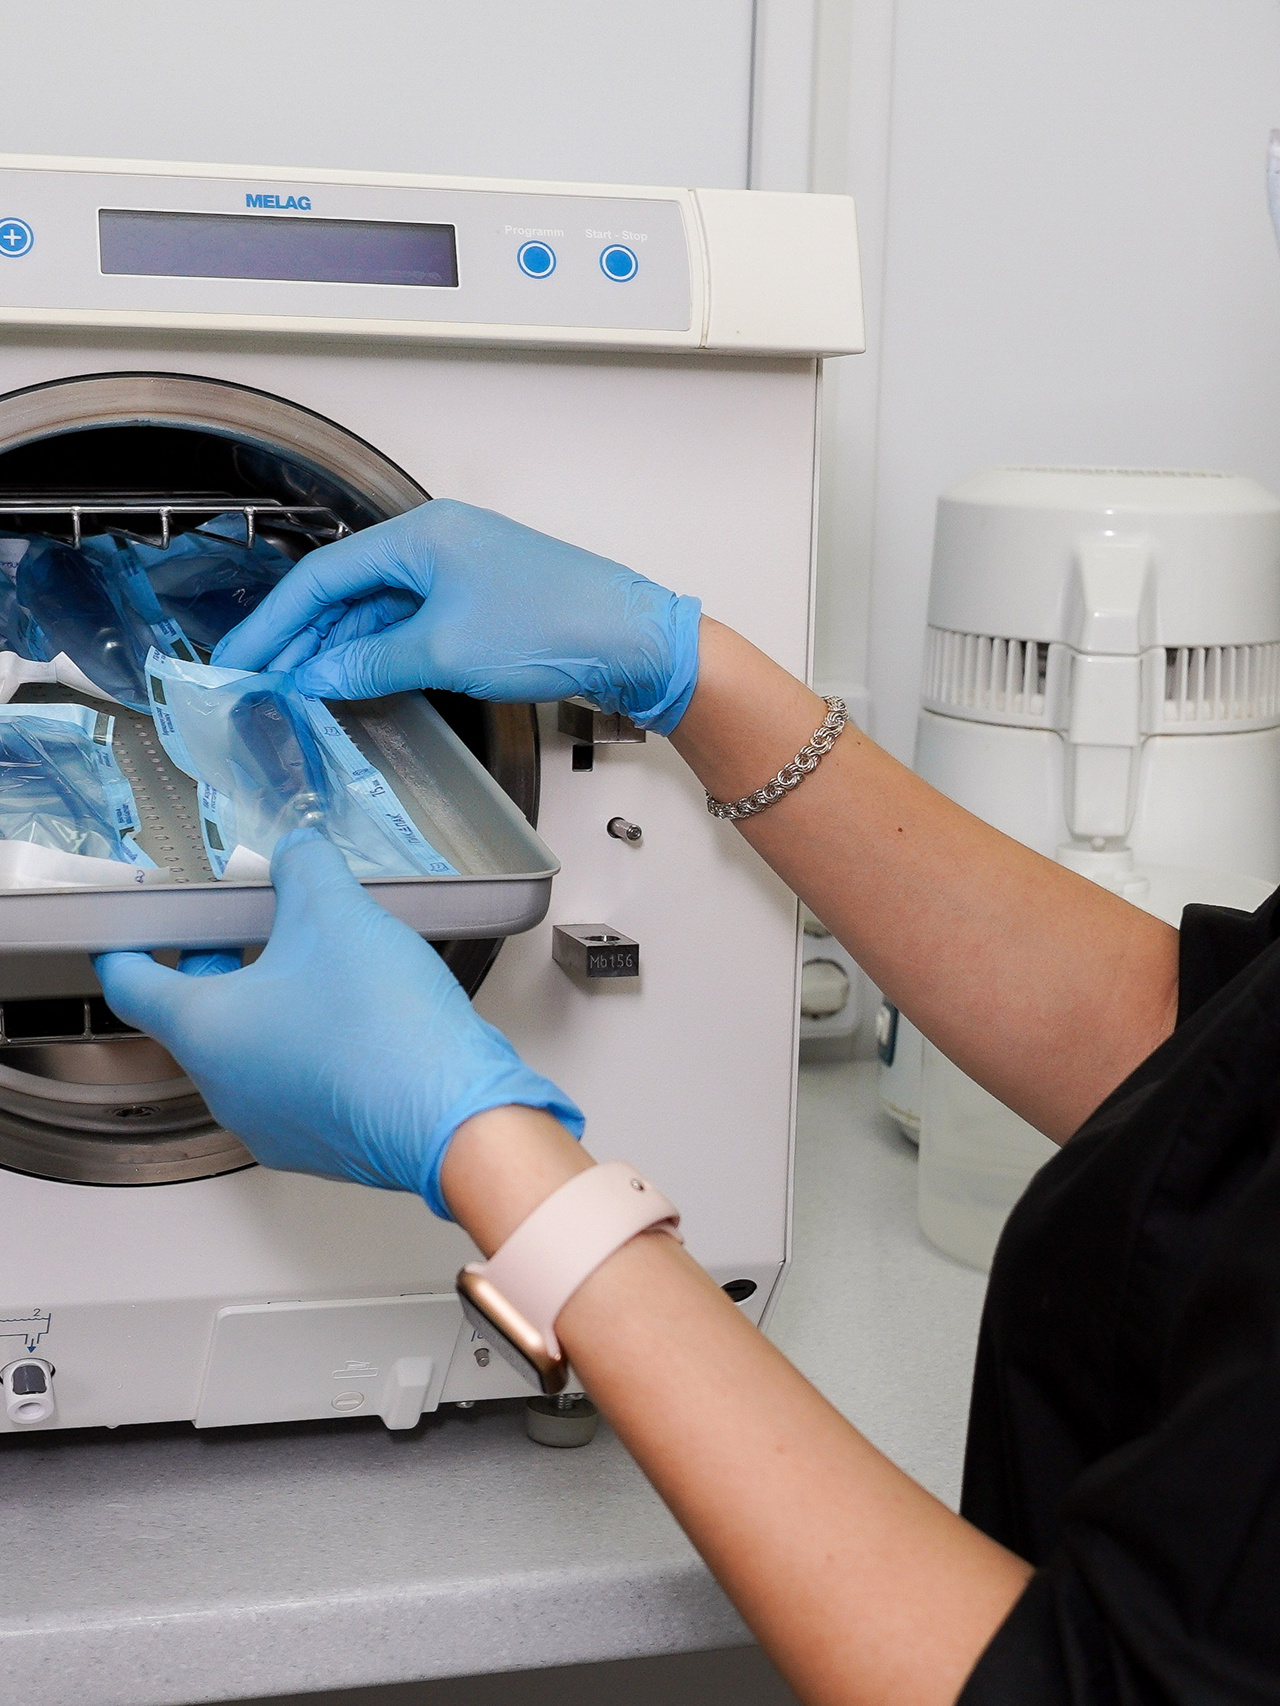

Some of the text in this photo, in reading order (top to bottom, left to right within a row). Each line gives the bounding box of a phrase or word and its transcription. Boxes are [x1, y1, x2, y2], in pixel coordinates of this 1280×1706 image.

[246, 193, 311, 210] MELAG
[504, 225, 564, 238] Programm
[585, 228, 612, 240] Start
[621, 230, 648, 243] Stop
[589, 953, 633, 969] Mb156
[33, 1308, 41, 1317] 2
